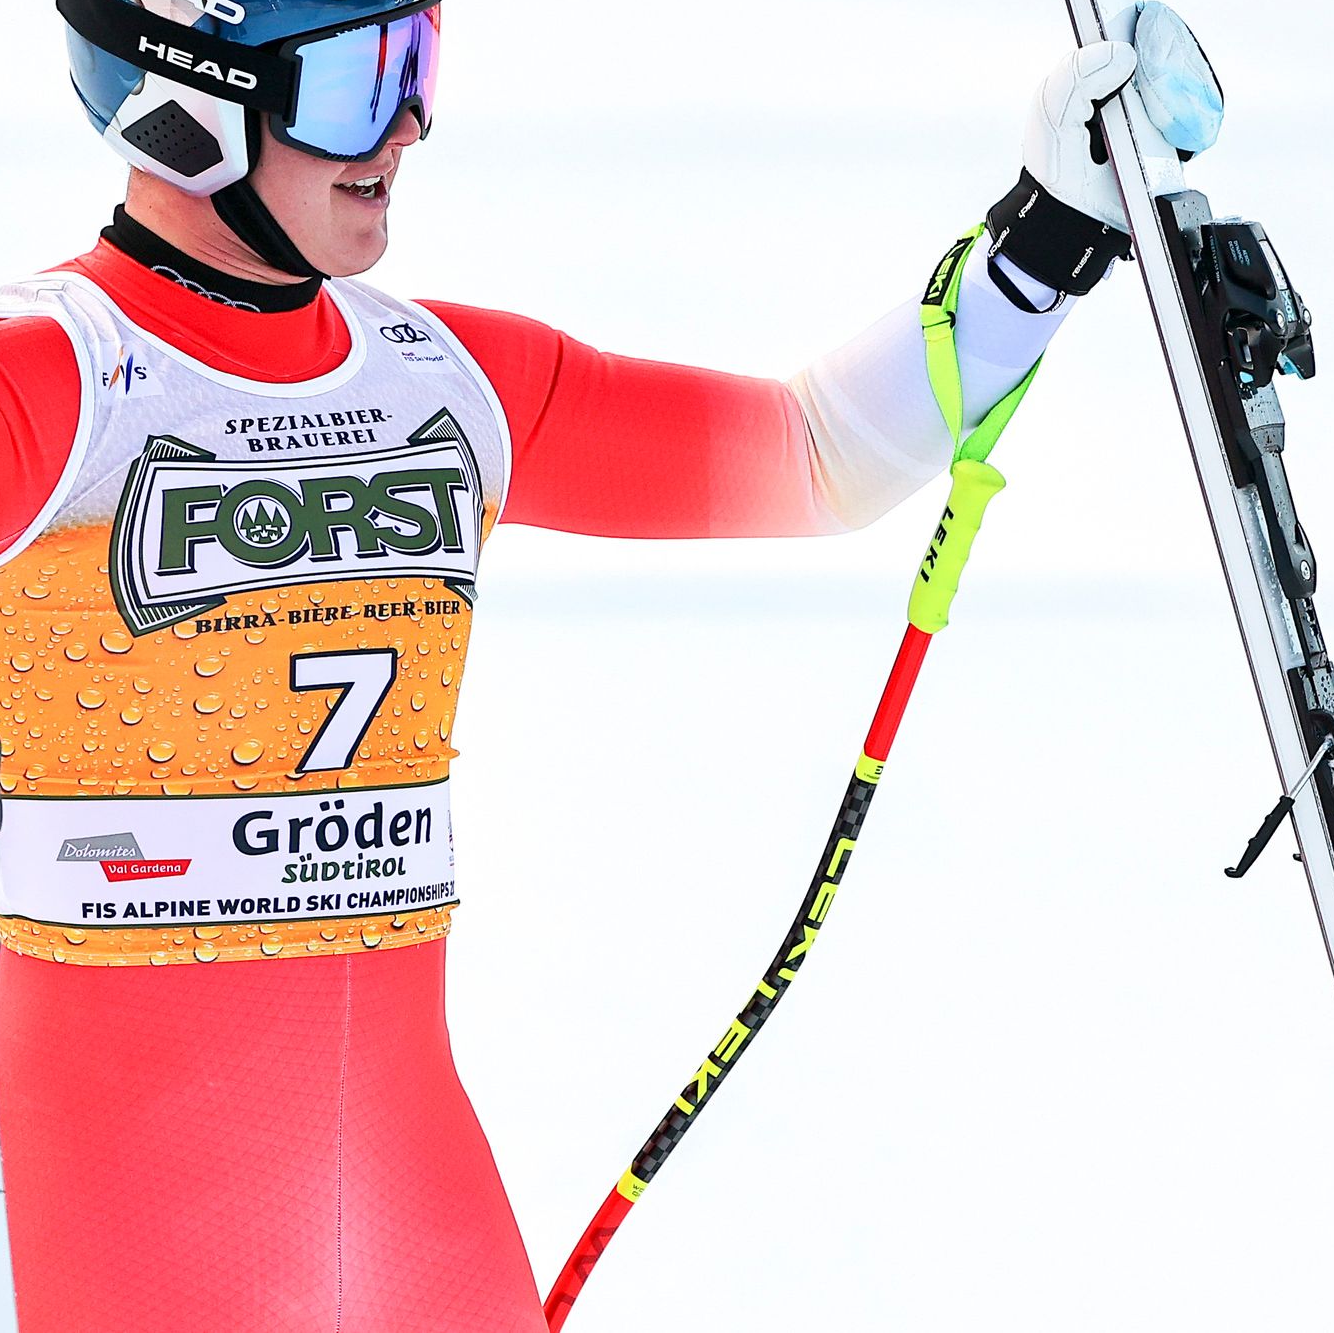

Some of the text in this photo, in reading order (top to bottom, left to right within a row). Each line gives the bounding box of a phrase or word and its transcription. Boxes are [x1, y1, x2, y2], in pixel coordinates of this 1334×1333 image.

[138, 35, 258, 90] HEAD
[926, 242, 966, 300] LEKI
[1071, 246, 1094, 278] reusch
[224, 408, 393, 435] SPEZIALBIER-
[246, 429, 378, 453] BRAUEREI
[153, 467, 469, 577] FORST
[920, 505, 955, 583] LEKI
[290, 646, 398, 775] 7
[64, 842, 137, 858] Dolomites
[232, 799, 432, 856] Gröden
[108, 864, 182, 874] Val Gardena
[81, 902, 117, 918] FIS
[122, 899, 211, 918] ALPINE
[216, 896, 301, 915] WORLD
[306, 893, 342, 912] SKI
[346, 881, 450, 909] CHAMPIONSHIPS
[777, 836, 857, 983] LEKI
[675, 978, 779, 1116] LEKI
